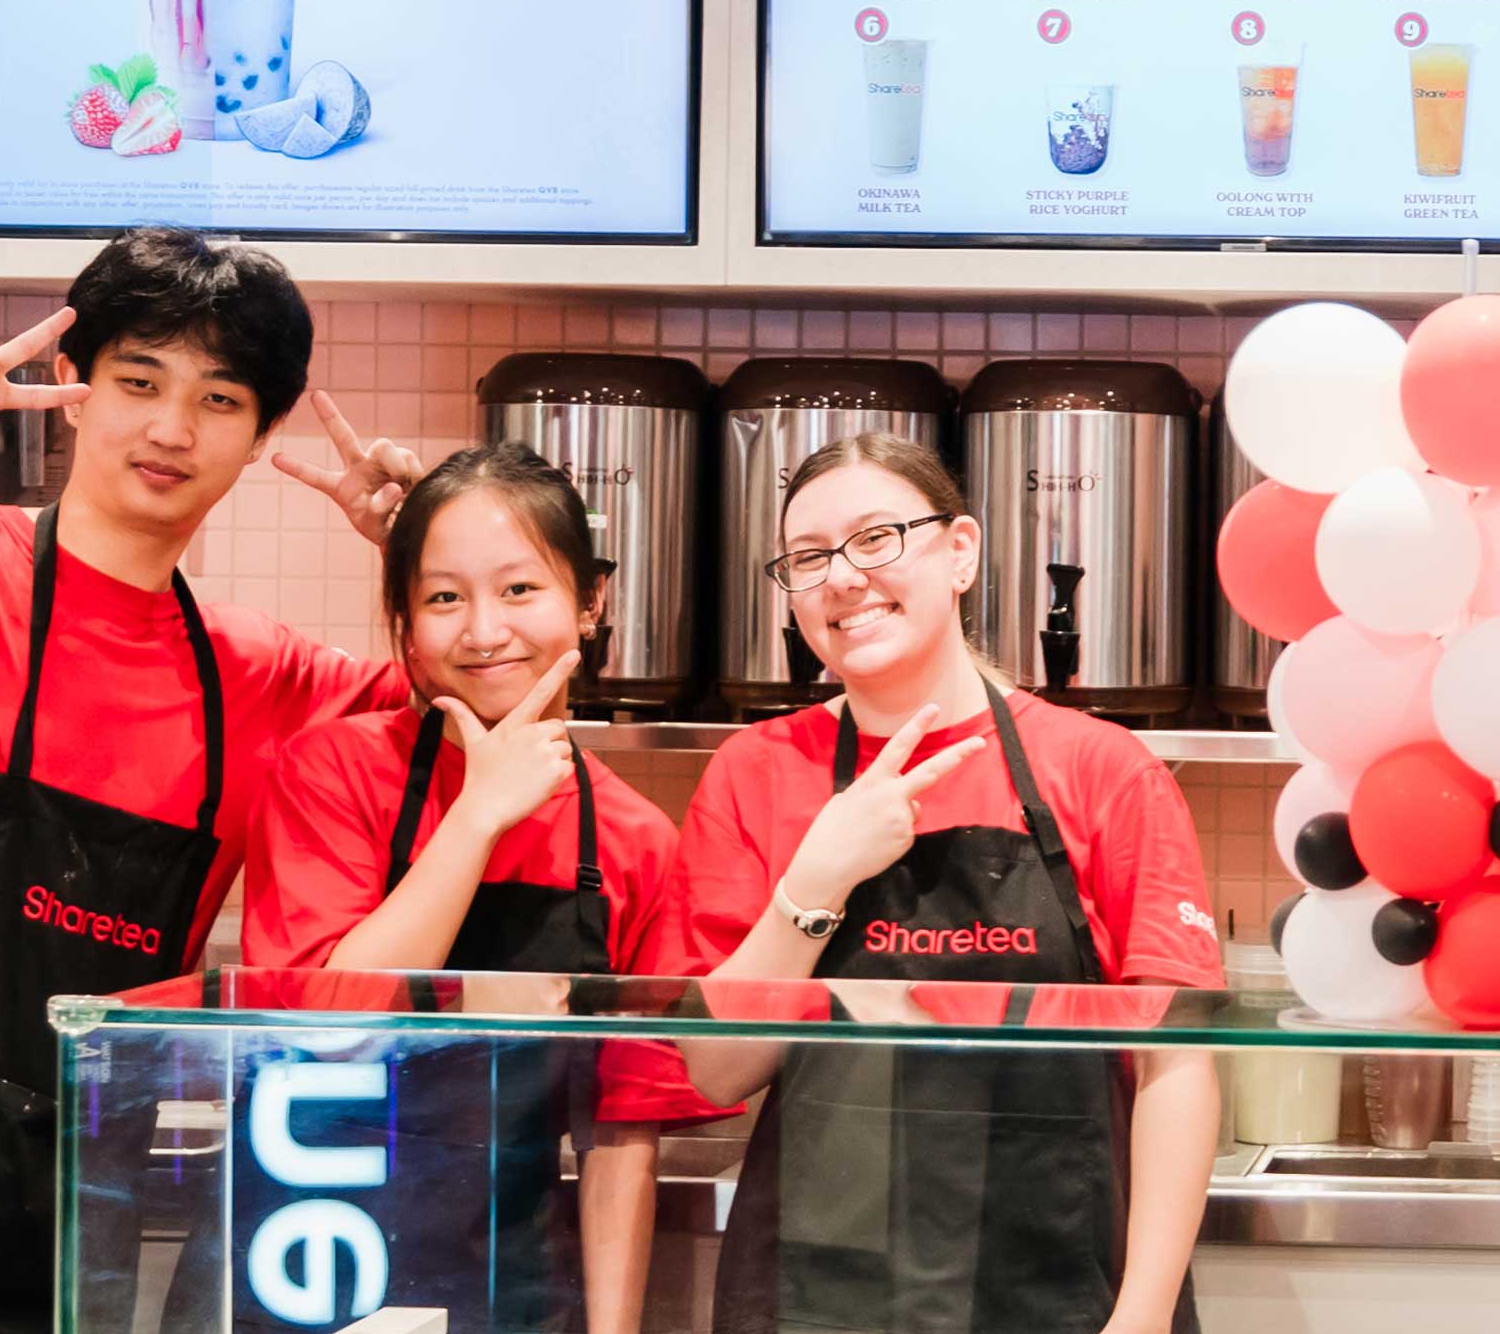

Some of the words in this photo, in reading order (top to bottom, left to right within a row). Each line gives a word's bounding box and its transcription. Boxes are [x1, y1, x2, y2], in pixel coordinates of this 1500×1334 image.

[862, 17, 880, 35] 6
[1045, 18, 1063, 36] 7
[1240, 20, 1257, 38] 8
[1402, 20, 1420, 39] 9
[868, 83, 922, 94] Sharetea
[1414, 88, 1465, 99] Sharetea
[858, 189, 921, 198] OKINAWA
[1026, 190, 1072, 200] STICKY
[1078, 191, 1129, 201] PURPLE
[1217, 192, 1273, 202] OOLONG
[1277, 193, 1313, 203] WITH
[1404, 194, 1476, 204] KIWIFRUIT
[857, 203, 892, 213] MILK
[895, 203, 921, 213] TEA
[1029, 204, 1060, 214] RICE
[1065, 205, 1127, 215] YOGHURT
[1227, 206, 1276, 217] CREAM
[1279, 207, 1307, 217] TOP
[1404, 208, 1447, 218] GREEN
[1450, 209, 1478, 218] TEA
[23, 885, 161, 956] Sharetea
[865, 920, 1037, 955] Sharetea
